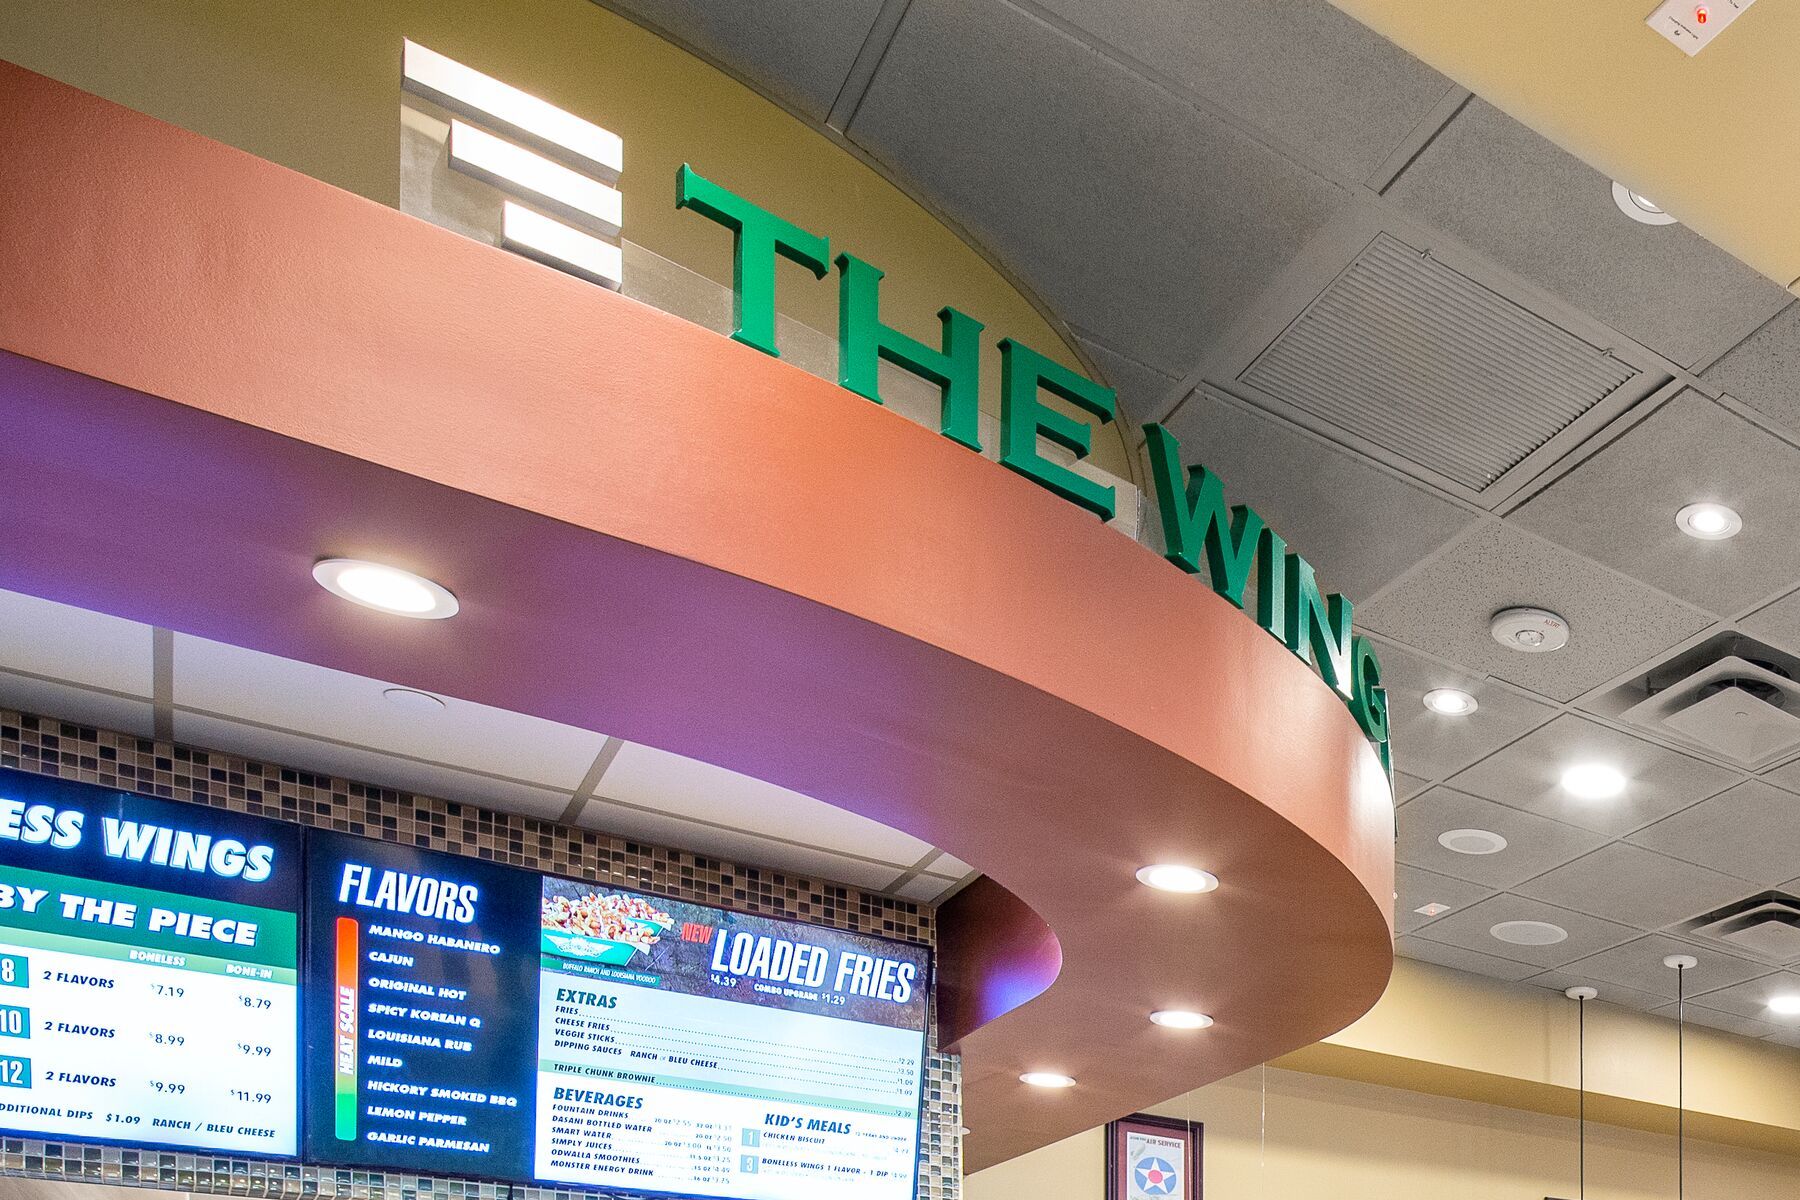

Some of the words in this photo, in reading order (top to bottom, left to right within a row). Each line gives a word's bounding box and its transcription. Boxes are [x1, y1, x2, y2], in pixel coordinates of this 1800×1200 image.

[675, 162, 1117, 523] THE
[102, 816, 275, 882] WINGS
[339, 863, 479, 924] FLAVORS
[59, 893, 138, 929] THE
[148, 907, 259, 947] PIECE
[368, 924, 425, 942] MANGO
[427, 934, 501, 954] HABANERO
[128, 949, 187, 967] BONELESS
[368, 951, 414, 967] CAJUN
[681, 922, 713, 944] NEW
[711, 928, 829, 988] LOADED
[833, 951, 916, 1003] FRIES
[1, 958, 15, 983] 8
[43, 970, 52, 981] 2
[56, 972, 115, 989] FLAVORS
[150, 983, 185, 998] $7.19
[238, 995, 272, 1010] $8.79
[562, 962, 583, 972] BUFFALO
[584, 966, 600, 974] RANCH
[600, 968, 611, 976] AND
[611, 970, 635, 981] LOUISIANA
[635, 973, 657, 984] VOODOO
[368, 977, 435, 996] ORIGINAL
[438, 987, 467, 1000] HOT
[556, 987, 618, 1010] EXTRAS
[710, 974, 737, 988] $4.39
[753, 983, 782, 996] COMBO
[821, 993, 846, 1006] $1.29
[339, 986, 355, 1034] SCALE
[368, 1003, 408, 1017] SPICY
[410, 1009, 467, 1026] KOREAN
[469, 1017, 482, 1028] Q
[555, 1005, 579, 1015] FRIES
[0, 1008, 23, 1034] 10
[44, 1021, 53, 1031] 2
[57, 1022, 116, 1039] FLAVORS
[149, 1031, 185, 1047] $8.99
[237, 1042, 272, 1057] $9.99
[555, 1017, 584, 1028] CHEESE
[587, 1021, 611, 1031] FRIES
[368, 1029, 441, 1048] LOUISIANA
[444, 1039, 473, 1051] RUB
[554, 1028, 585, 1039] VEGGIE
[587, 1032, 616, 1043] STICKS
[339, 1034, 355, 1075] HEAT
[367, 1055, 403, 1067] MILD
[554, 1039, 590, 1051] DIPPING
[592, 1044, 623, 1056] SAUCES
[630, 1050, 658, 1061] RANCH
[668, 1055, 688, 1065] BLEU
[690, 1058, 719, 1069] CHEESE
[0, 1059, 24, 1085] 12
[45, 1071, 54, 1081] 2
[58, 1072, 117, 1088] FLAVORS
[150, 1080, 186, 1095] $9.99
[230, 1089, 272, 1104] $11.99
[554, 1063, 582, 1074] TRIPLE
[584, 1067, 614, 1078] CHUNK
[616, 1071, 656, 1084] BROWNIE
[367, 1080, 428, 1096] HICKORY
[430, 1088, 487, 1103] SMOKED
[489, 1094, 518, 1107] BBQ
[553, 1086, 644, 1110] BEVERAGES
[367, 1106, 416, 1120] LEMON
[418, 1111, 467, 1126] PEPPER
[552, 1103, 595, 1116] FOUNTAIN
[597, 1109, 629, 1119] DRINKS
[67, 1109, 94, 1121] DIPS
[105, 1113, 141, 1125] $1.09
[152, 1118, 191, 1130] RANCH
[206, 1123, 234, 1134] BLEU
[237, 1126, 276, 1138] CHEESE
[551, 1126, 580, 1136] SMART
[583, 1130, 612, 1139] WATER
[552, 1115, 584, 1125] DASANI
[586, 1119, 623, 1129] BOTTLED
[624, 1123, 653, 1133] WATER
[806, 1118, 852, 1135] MEALS
[367, 1131, 416, 1146] GARLIC
[418, 1136, 490, 1152] PARMESAN
[551, 1137, 583, 1148] SIMPLY
[585, 1141, 612, 1151] JUICES
[763, 1131, 796, 1142] CHICKEN
[797, 1135, 825, 1145] BISCUIT
[551, 1148, 591, 1160] ODWALLA
[593, 1153, 641, 1165] SMOOTHIES
[761, 1158, 798, 1168] BONELESS
[800, 1161, 824, 1171] WINGS
[833, 1165, 861, 1175] FLAVOR
[550, 1160, 591, 1171] MONSTER
[593, 1164, 626, 1174] ENERGY
[628, 1168, 654, 1177] DRINK
